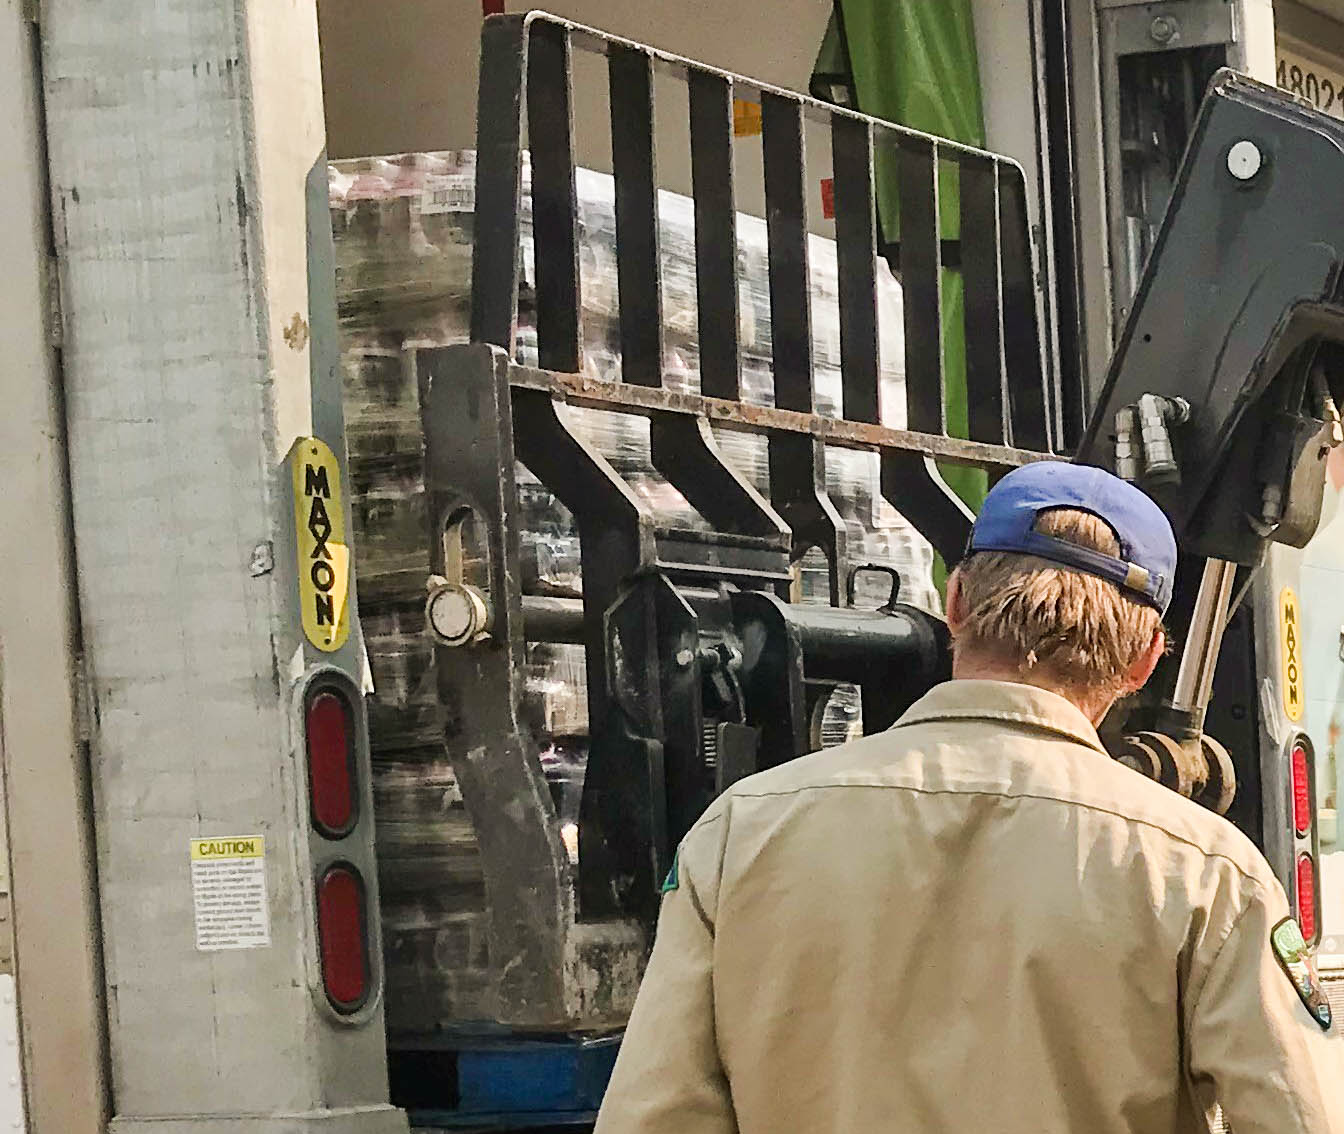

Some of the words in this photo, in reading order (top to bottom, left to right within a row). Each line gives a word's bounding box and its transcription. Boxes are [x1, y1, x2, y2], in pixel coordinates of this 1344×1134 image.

[304, 463, 335, 626] MAXON
[1285, 604, 1298, 705] MAXON
[199, 841, 255, 856] CAUTION
